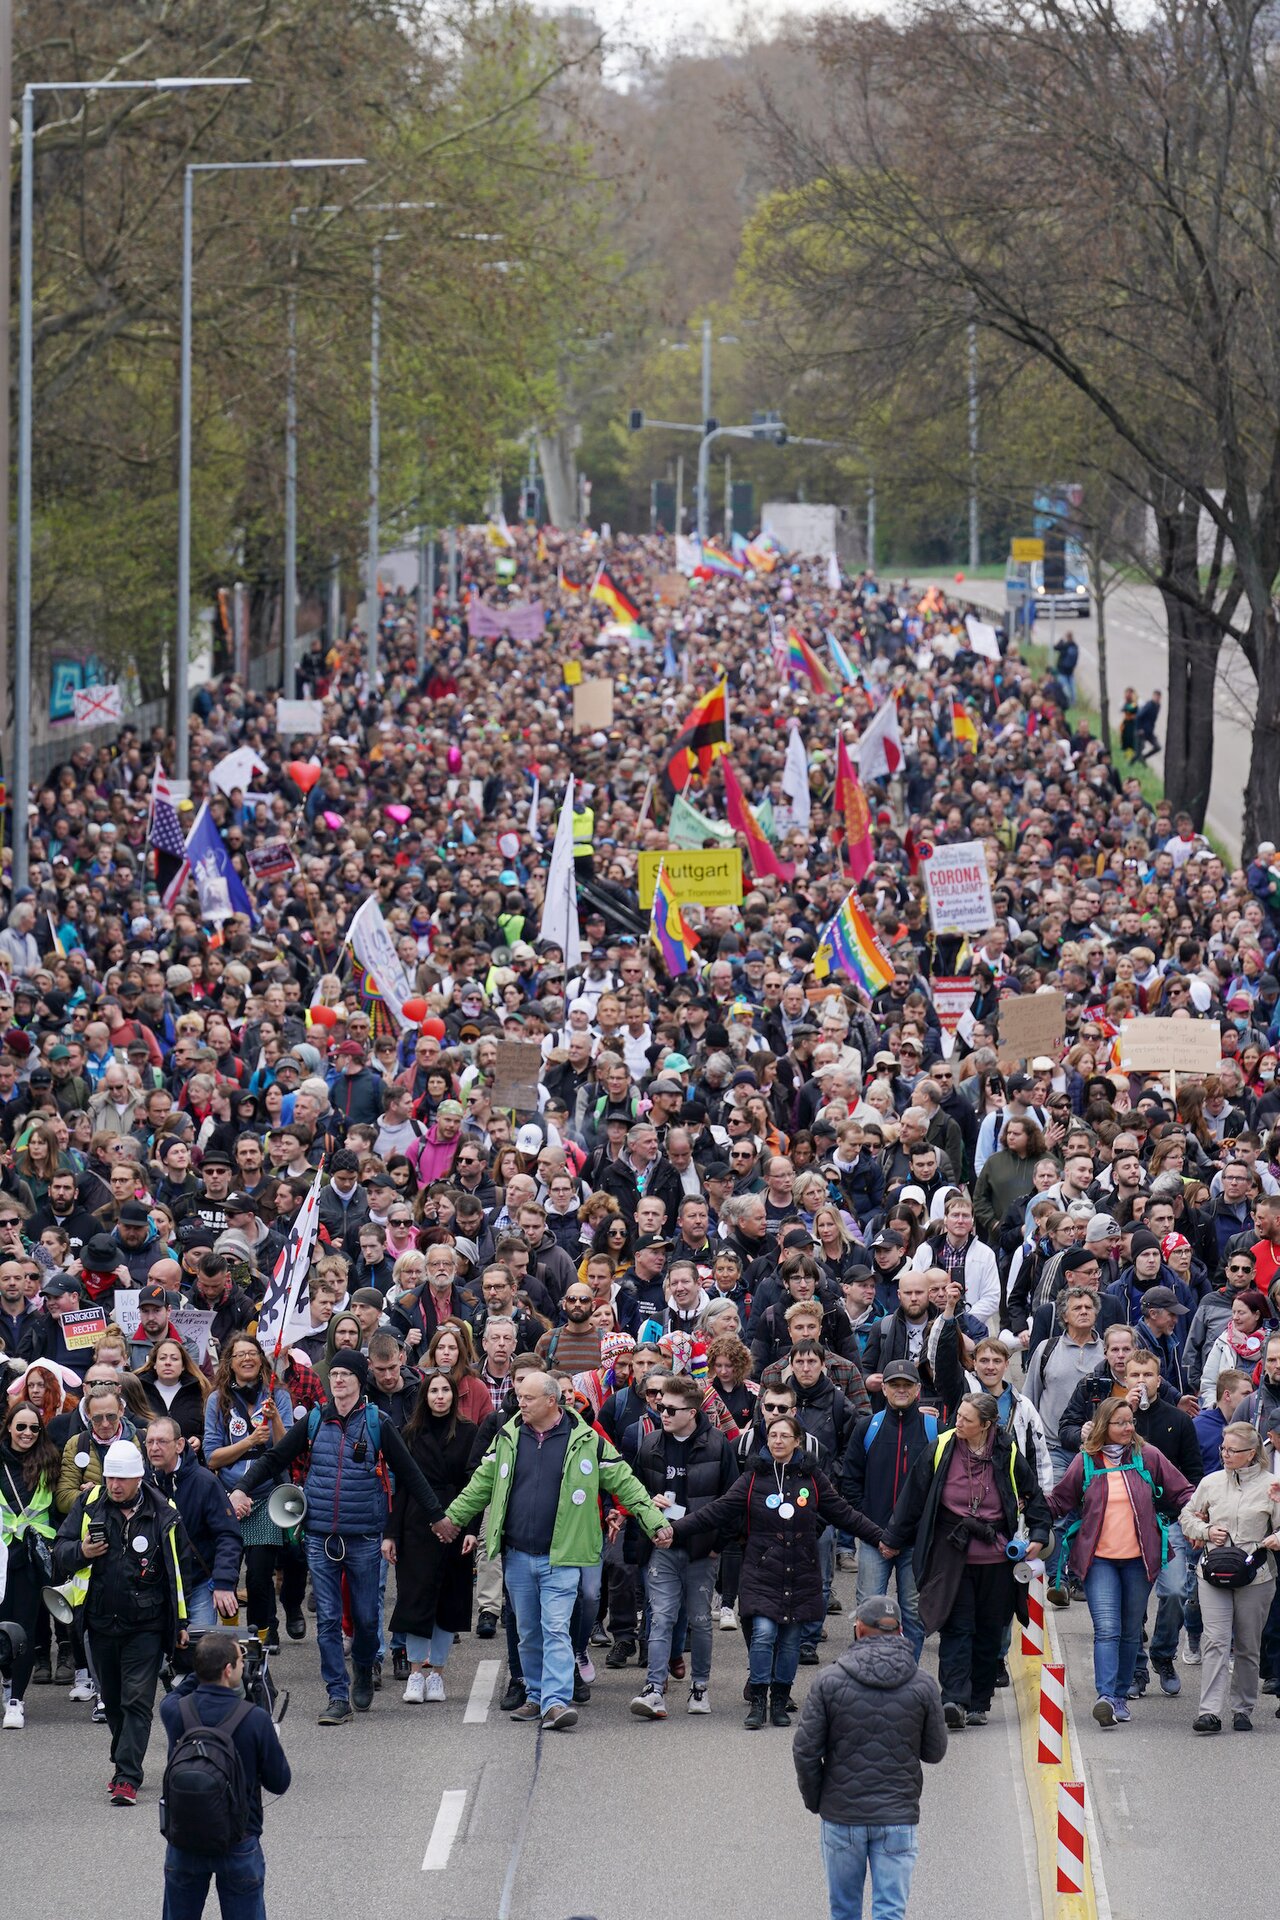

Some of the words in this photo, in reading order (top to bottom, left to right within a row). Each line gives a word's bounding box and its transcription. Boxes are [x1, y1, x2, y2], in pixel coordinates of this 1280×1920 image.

[652, 863, 729, 881] Stuttgart
[929, 865, 982, 886] CORONA
[932, 882, 984, 897] FEHLALARM?
[1182, 1034, 1197, 1043] Tod
[64, 1310, 100, 1323] EINIGKEIT
[72, 1323, 98, 1335] RECHT
